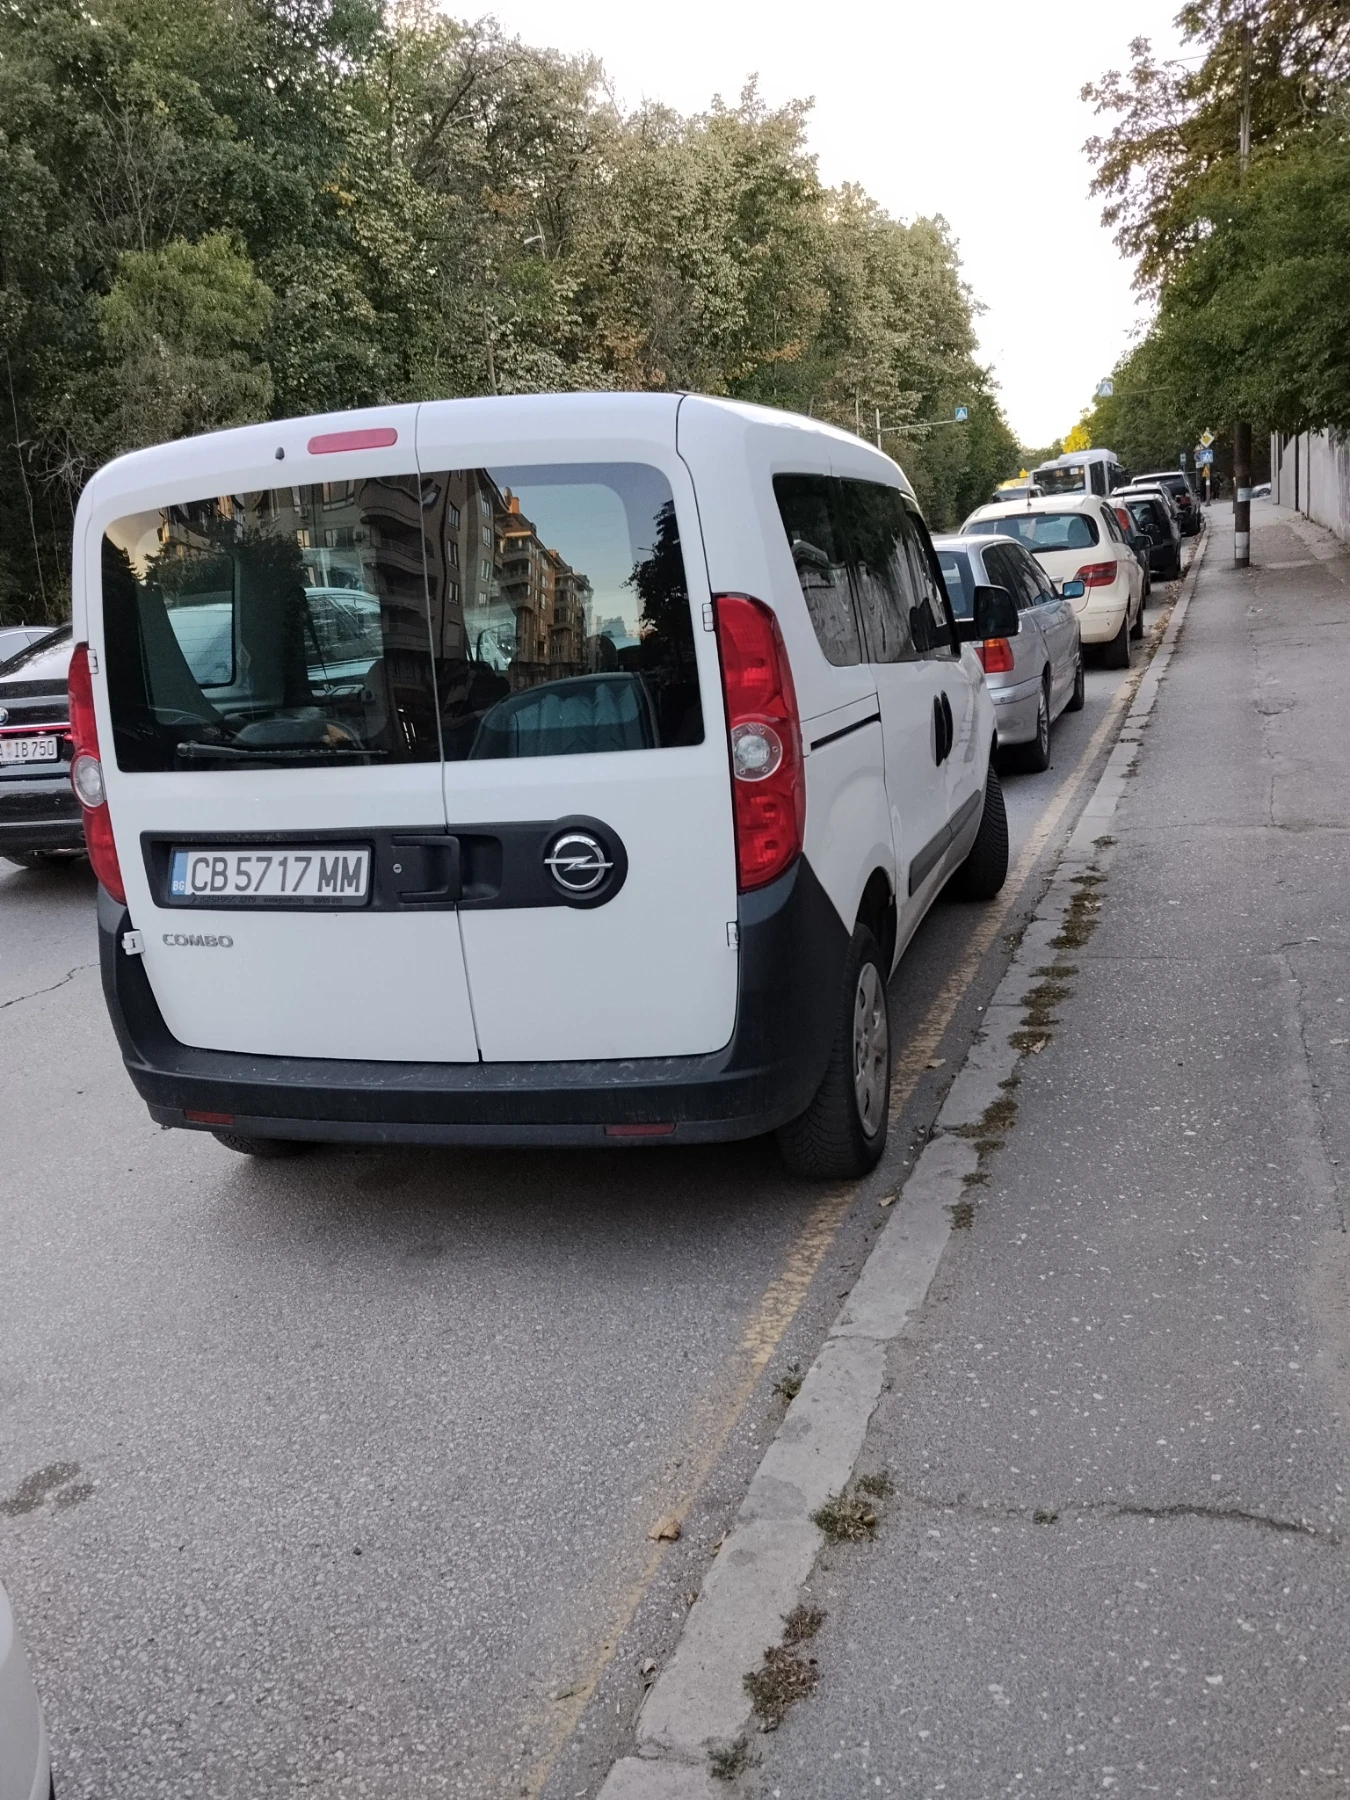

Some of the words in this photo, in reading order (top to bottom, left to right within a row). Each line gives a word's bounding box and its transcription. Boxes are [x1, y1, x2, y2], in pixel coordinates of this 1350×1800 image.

[234, 856, 313, 893] 5717
[172, 881, 185, 891] BG
[162, 933, 234, 948] COMBO
